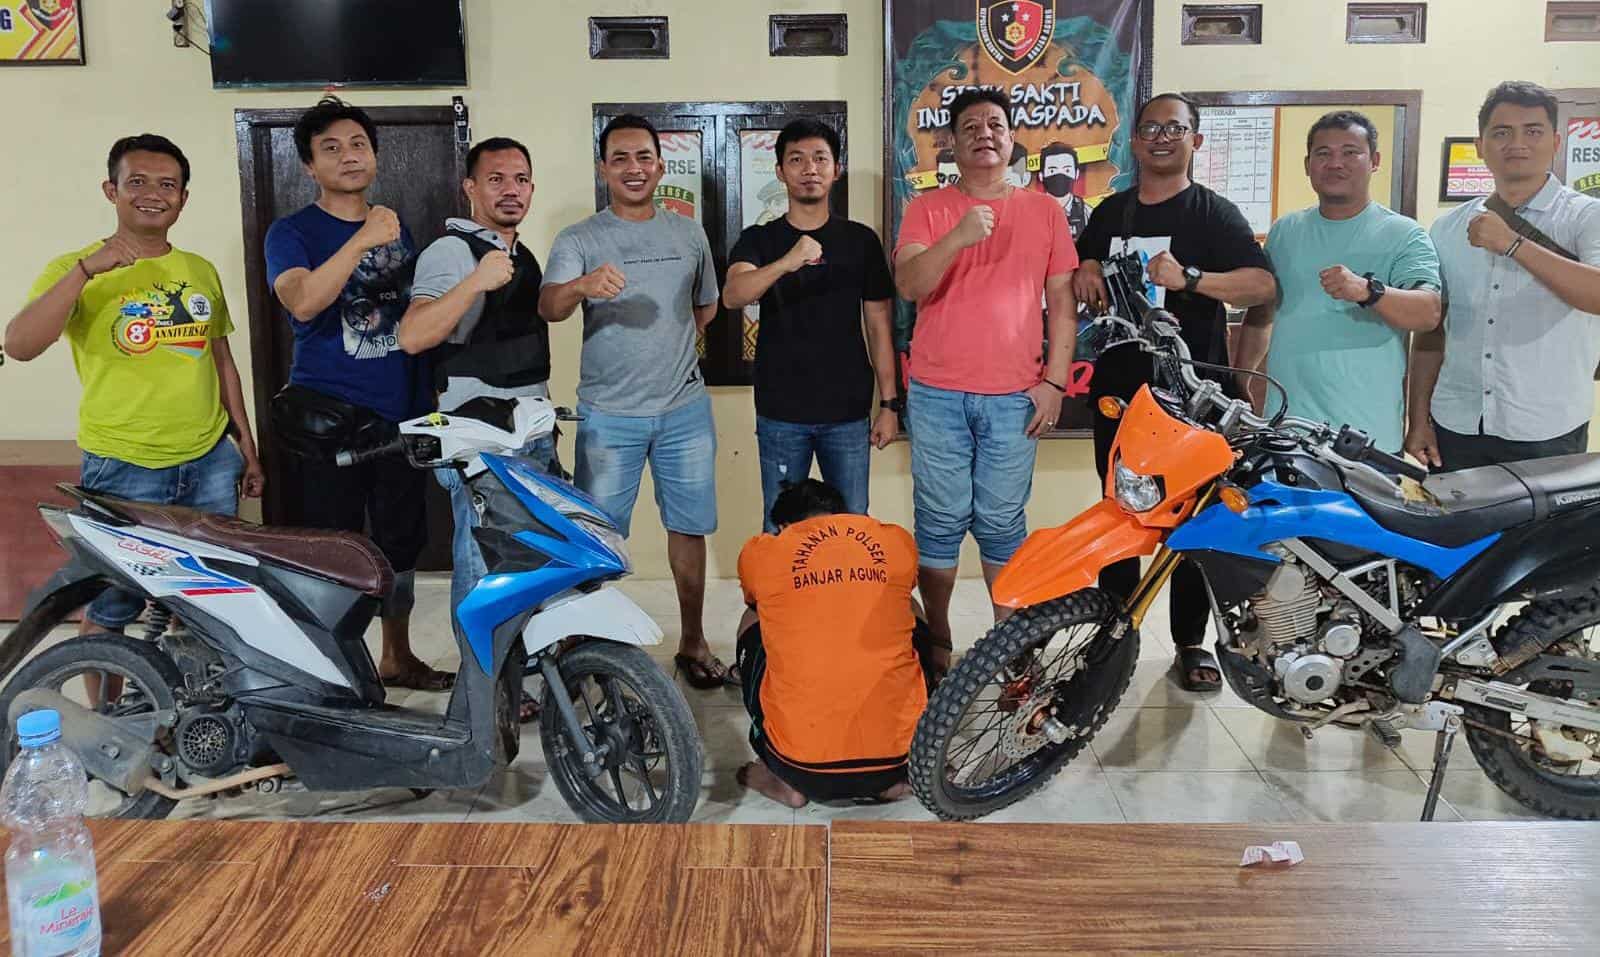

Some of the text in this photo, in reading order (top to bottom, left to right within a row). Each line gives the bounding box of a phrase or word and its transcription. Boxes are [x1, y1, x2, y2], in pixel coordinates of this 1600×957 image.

[1010, 82, 1080, 104] SAKTI
[1011, 104, 1105, 126] ASPADA
[792, 525, 888, 573] TAHANAN POLSEK
[793, 567, 887, 589] BANJAR AGUNG
[61, 907, 77, 920] Le
